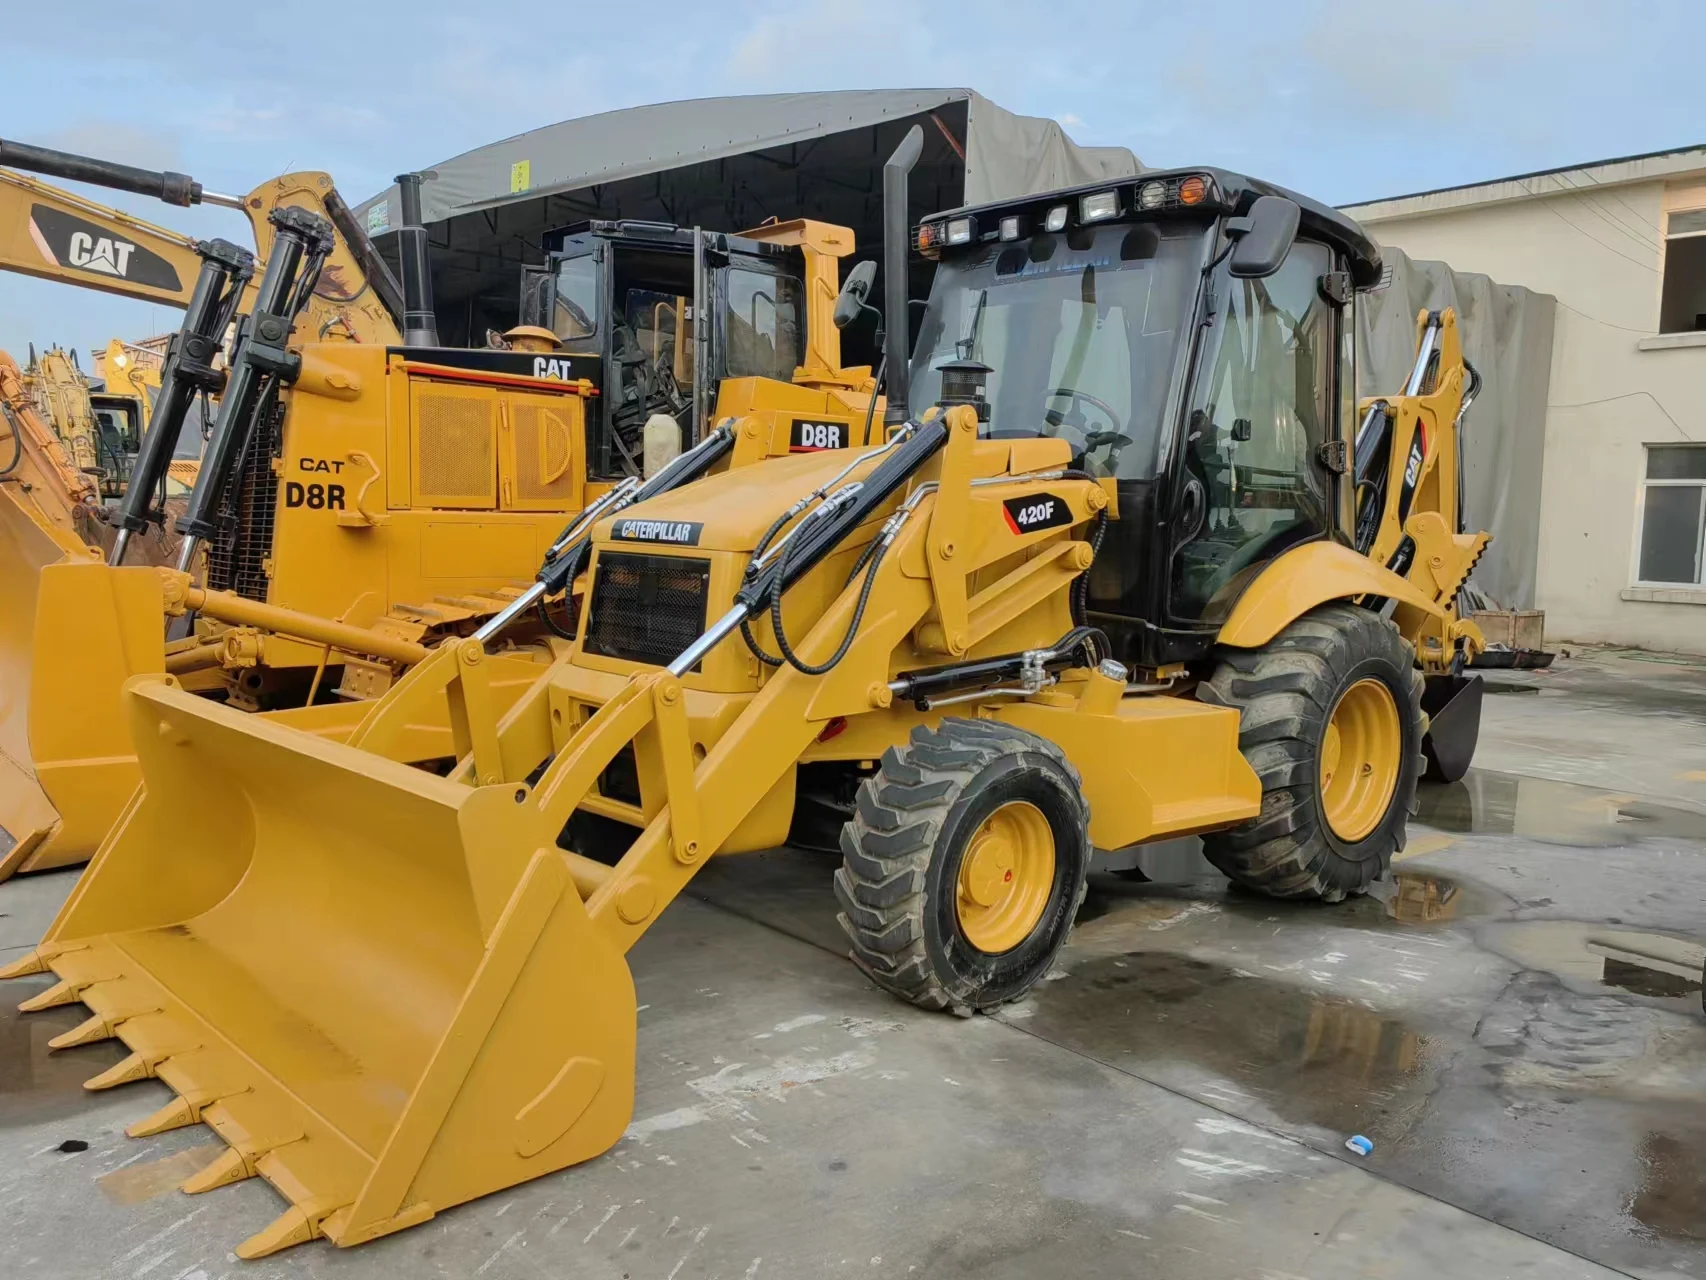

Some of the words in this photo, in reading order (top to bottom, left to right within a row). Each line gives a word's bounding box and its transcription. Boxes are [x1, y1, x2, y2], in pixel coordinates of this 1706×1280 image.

[68, 231, 135, 277] CAT
[533, 356, 571, 380] CAT
[801, 423, 840, 448] D8R
[300, 458, 345, 474] CAT
[1405, 443, 1422, 488] CAT
[286, 481, 345, 510] D8R
[1017, 500, 1055, 525] 420F
[621, 520, 692, 541] CATERPILLAR
